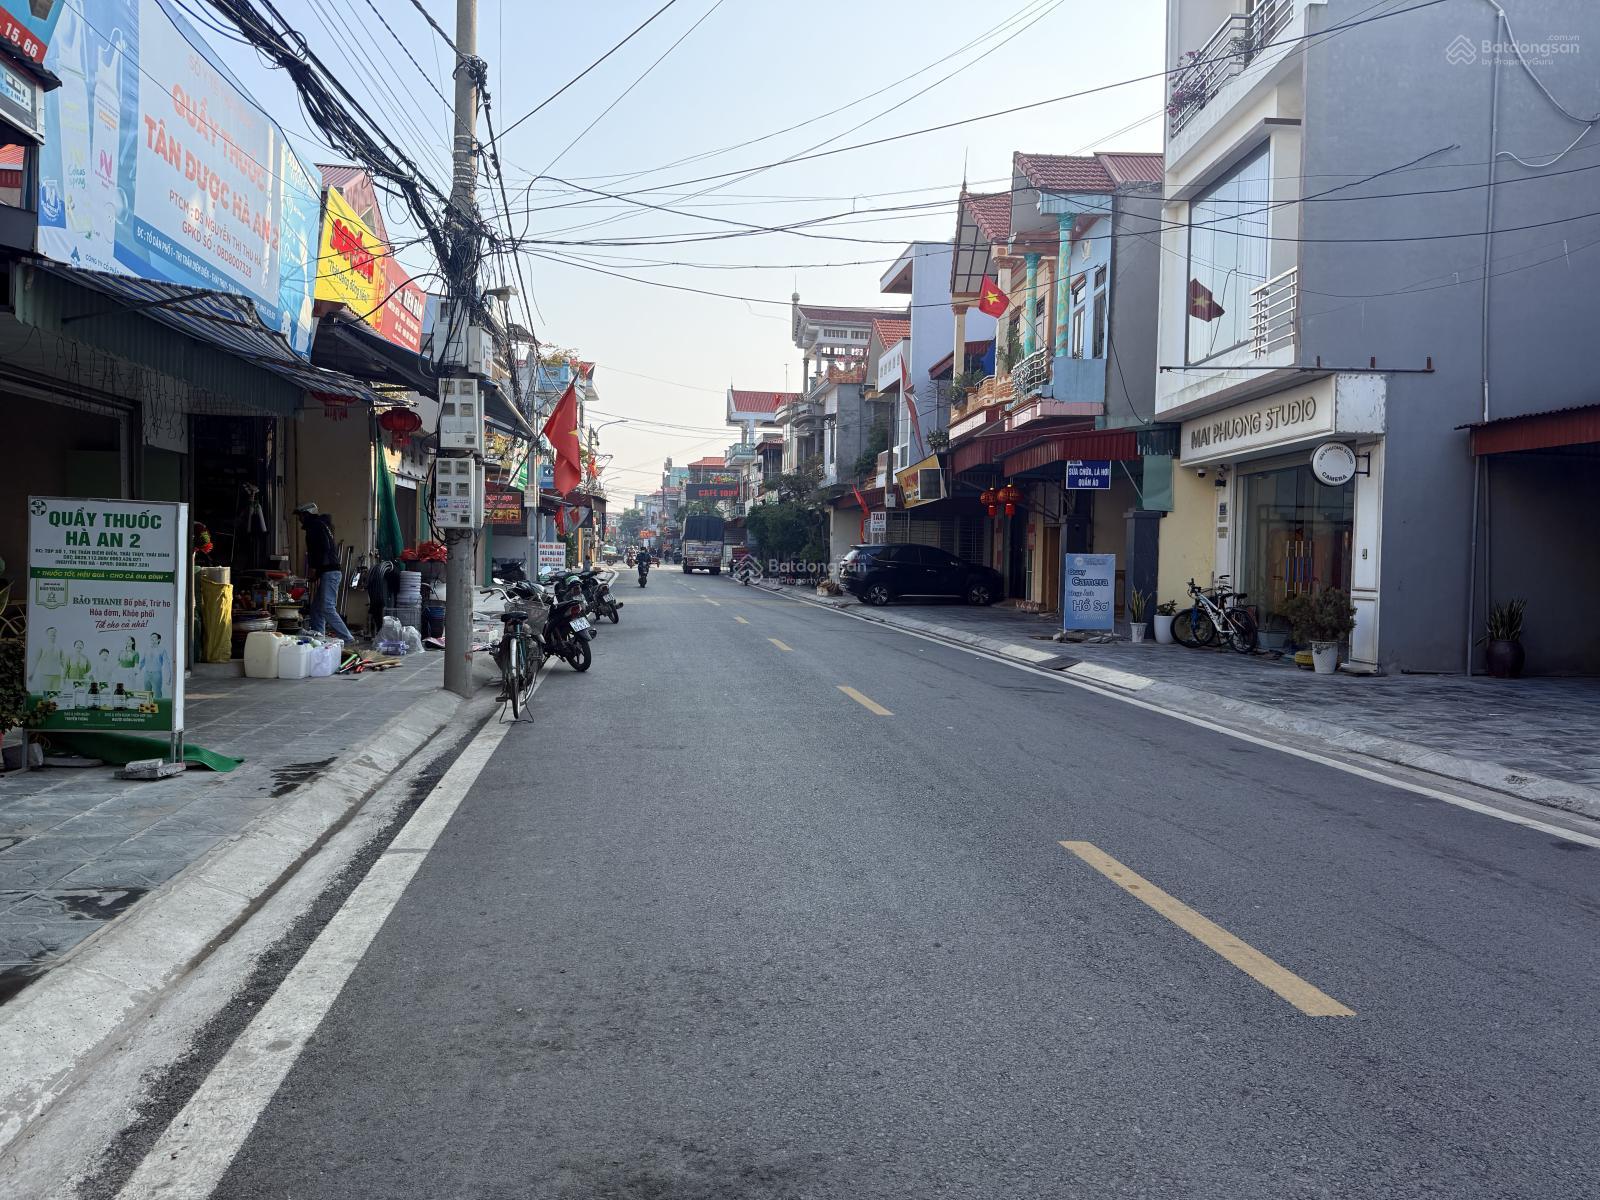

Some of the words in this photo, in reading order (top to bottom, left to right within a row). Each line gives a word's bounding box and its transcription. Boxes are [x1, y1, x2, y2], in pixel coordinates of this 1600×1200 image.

[144, 113, 182, 172] TÂN
[185, 149, 230, 209] DƯỢC
[232, 190, 251, 229] HÀ
[252, 211, 270, 244] AN
[169, 189, 190, 215] PTCM
[194, 208, 204, 225] DS
[205, 215, 232, 244] NGUYỄN
[182, 220, 202, 243] GPKD
[1190, 428, 1211, 450] MAI
[1213, 411, 1262, 444] PHUONG
[1265, 396, 1317, 431] STUDIO
[1321, 471, 1348, 482] CAMERA
[103, 509, 162, 530] THUỐC
[872, 513, 885, 521] TAXI
[65, 529, 91, 547] HÀ
[97, 532, 123, 548] AN
[129, 533, 141, 549] 2
[1072, 576, 1109, 587] Camera
[72, 594, 91, 605] BẢO
[92, 597, 122, 606] THANH
[162, 599, 171, 608] ho
[1072, 598, 1091, 612] Hồ
[1093, 599, 1110, 612] Sơ
[106, 620, 119, 629] cho
